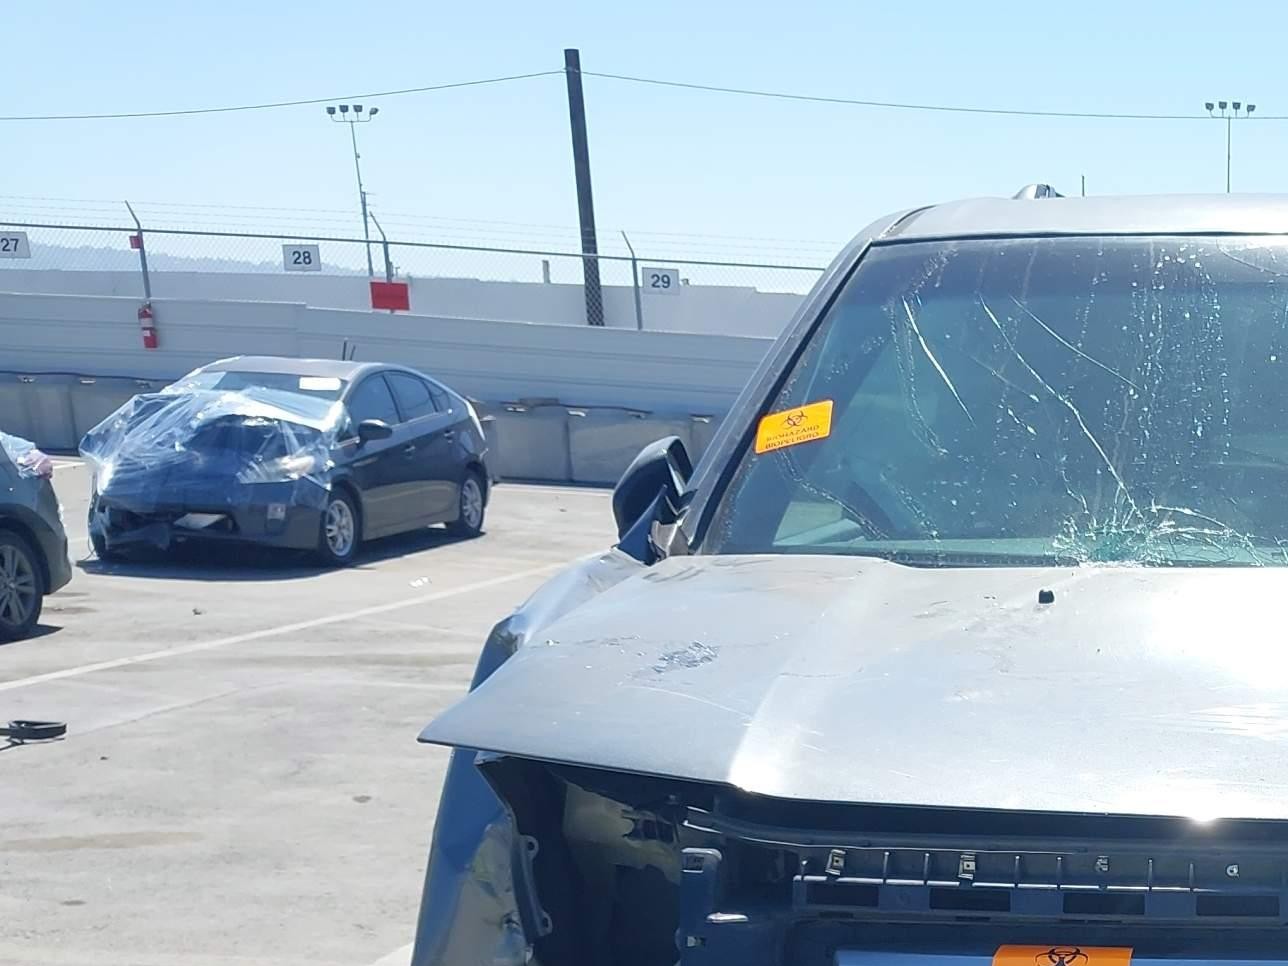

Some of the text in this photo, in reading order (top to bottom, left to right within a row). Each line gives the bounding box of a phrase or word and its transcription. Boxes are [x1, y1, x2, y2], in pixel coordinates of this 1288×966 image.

[1, 237, 19, 252] 27
[292, 250, 312, 265] 28
[650, 273, 671, 289] 29
[765, 432, 820, 450] BIOPELIGRO
[766, 425, 820, 442] BIOHAZARD
